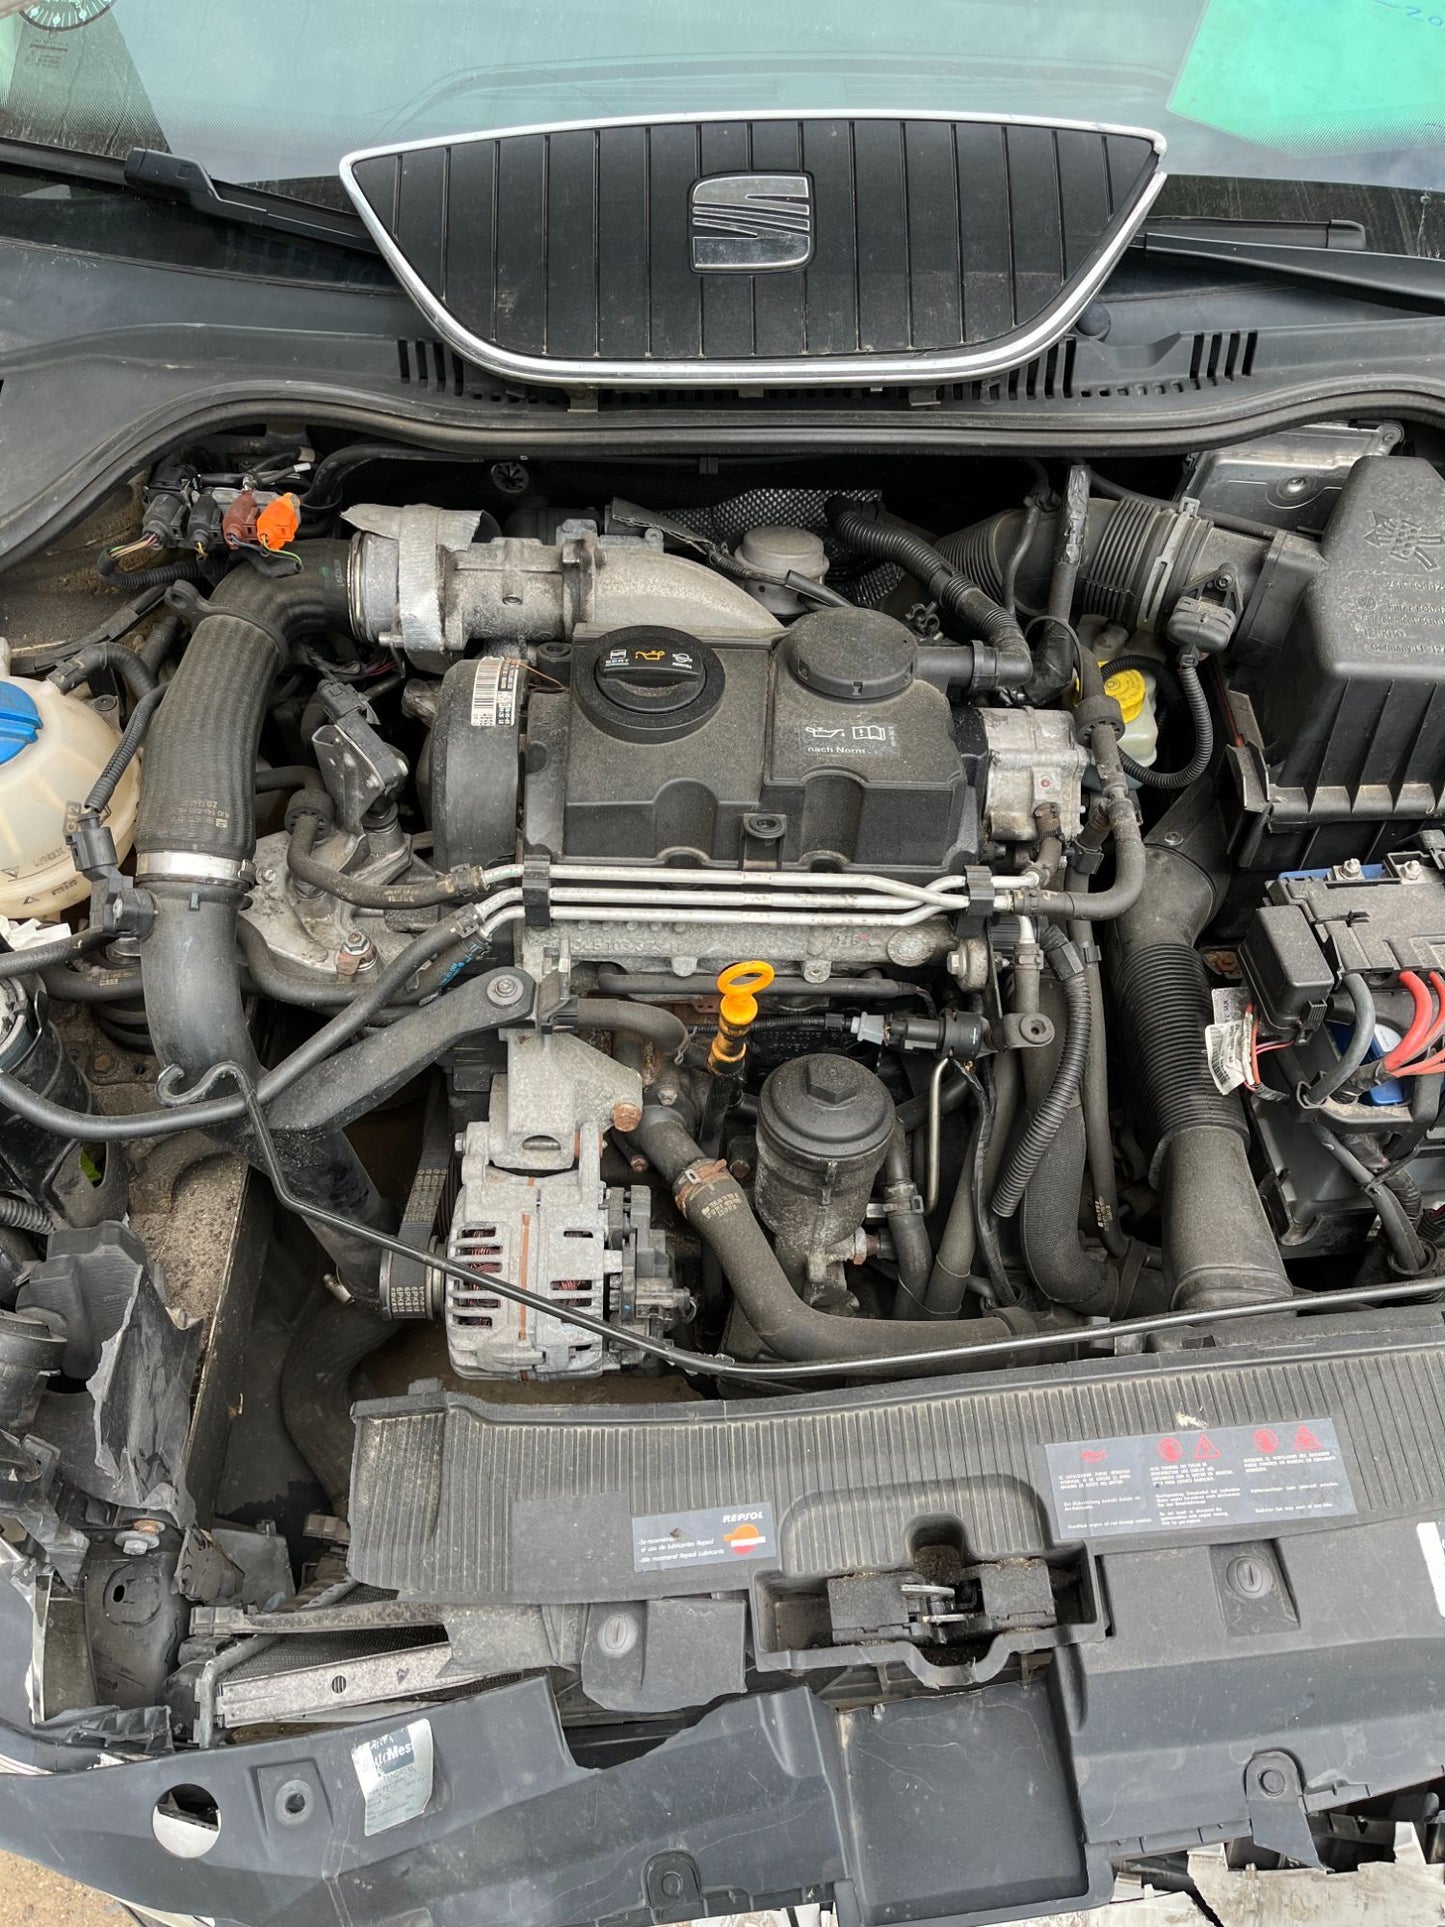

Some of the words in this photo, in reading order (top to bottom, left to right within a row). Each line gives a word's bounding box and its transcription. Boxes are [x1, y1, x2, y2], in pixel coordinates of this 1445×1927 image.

[836, 746, 866, 754] Norm
[66, 804, 80, 832] G12
[722, 1511, 763, 1523] REPSOL
